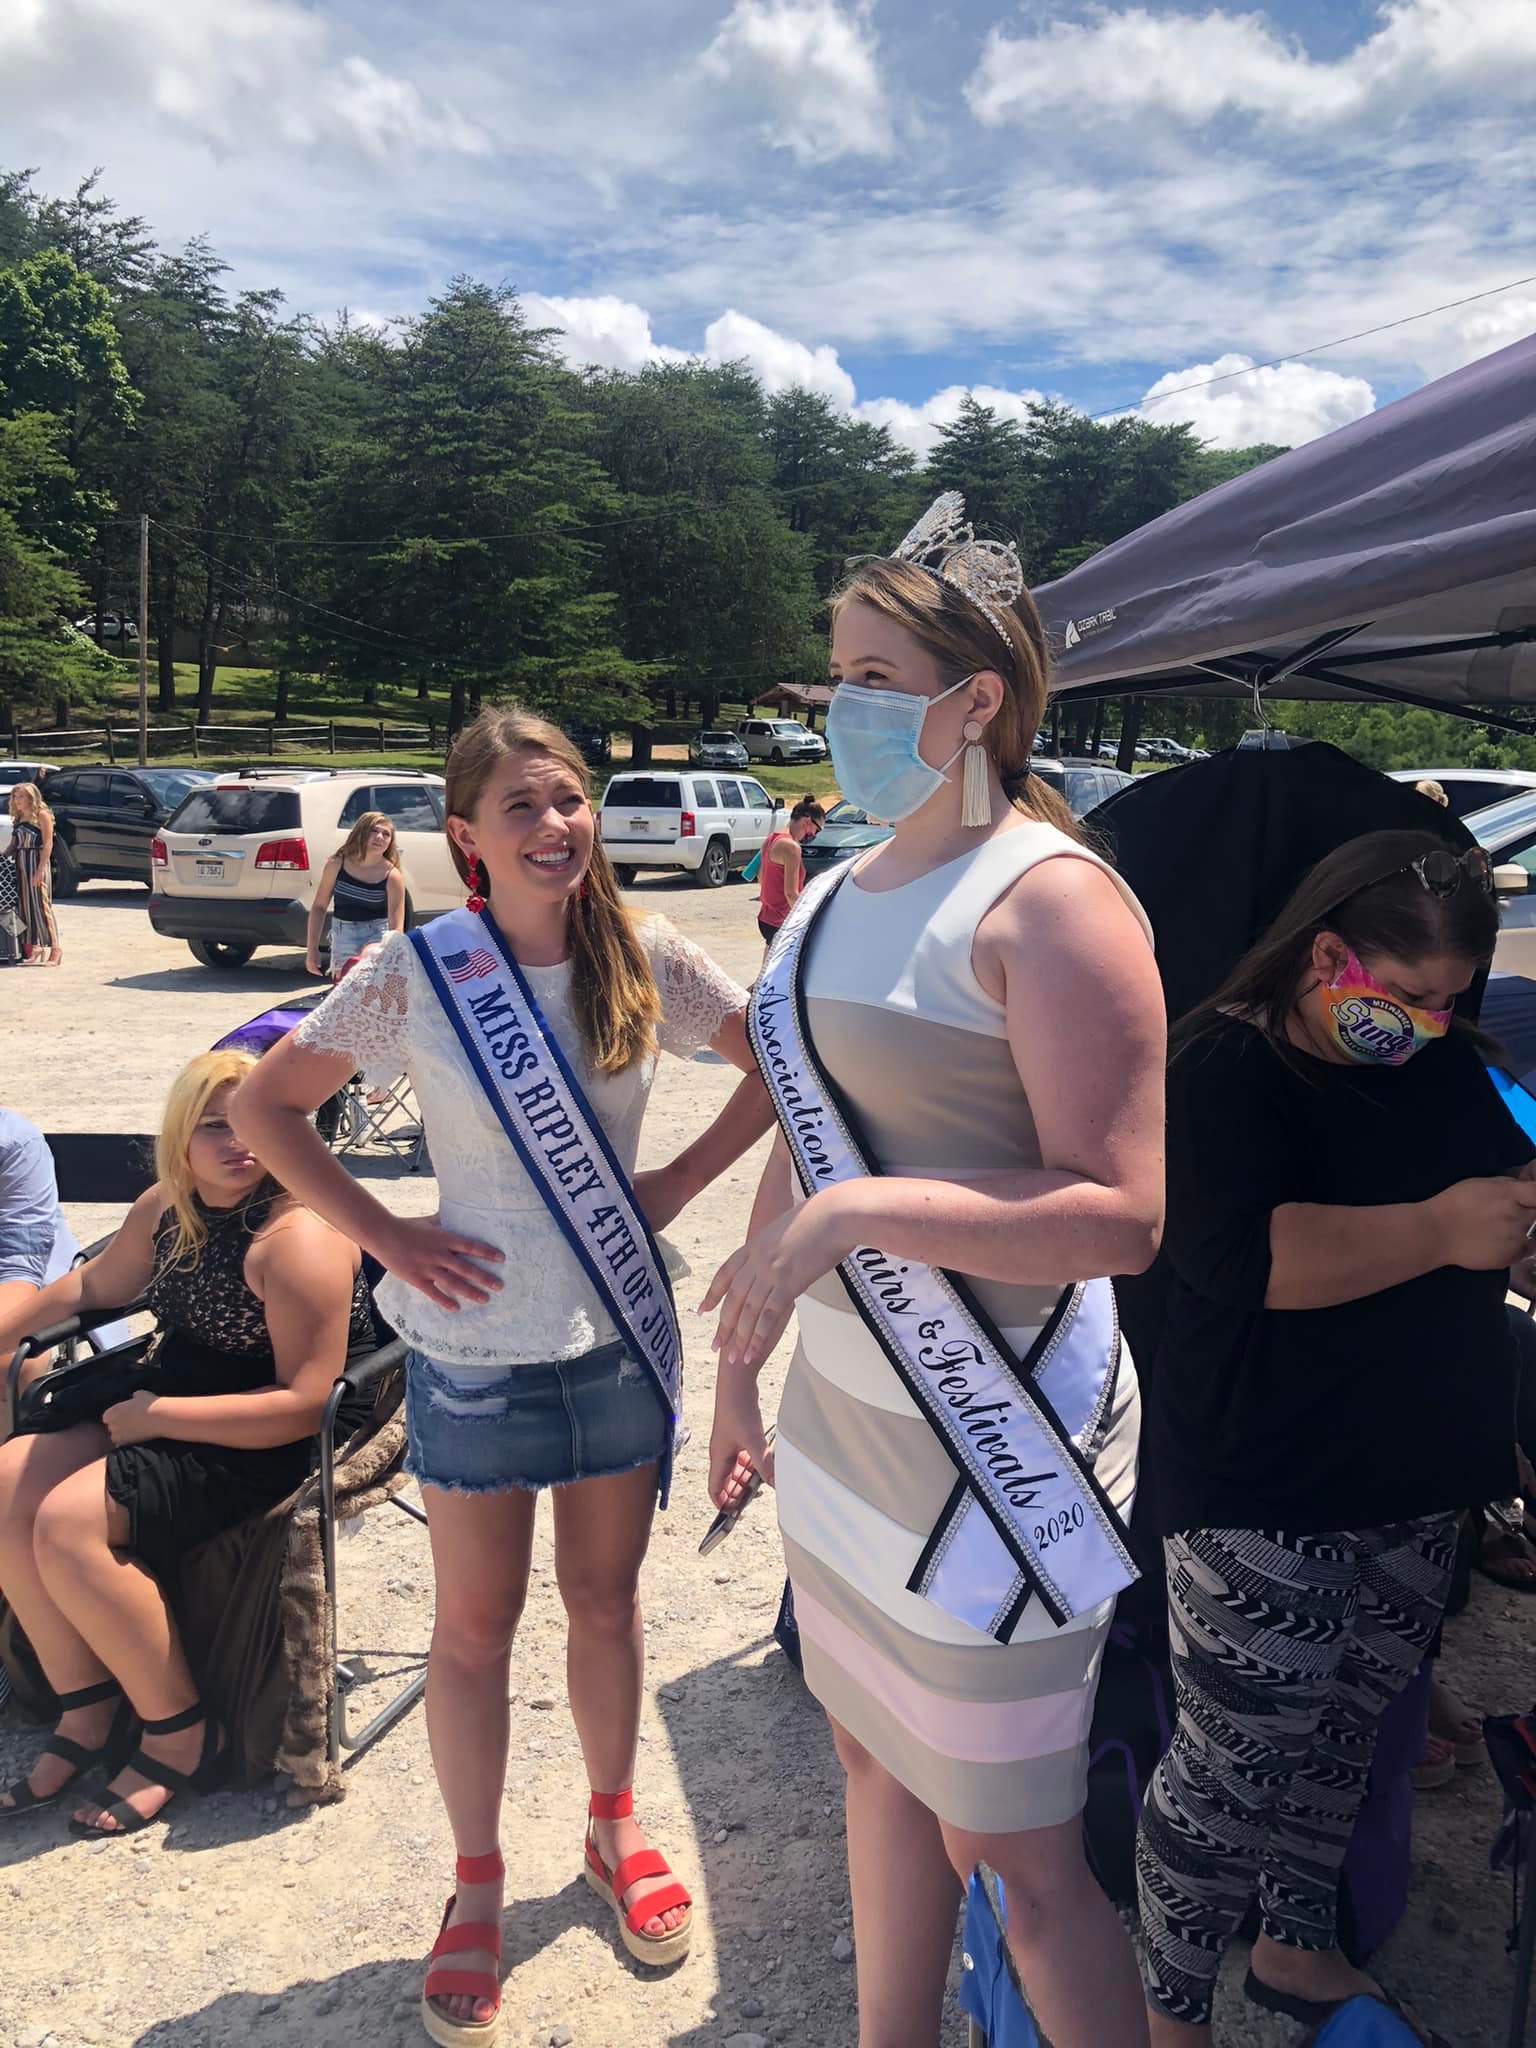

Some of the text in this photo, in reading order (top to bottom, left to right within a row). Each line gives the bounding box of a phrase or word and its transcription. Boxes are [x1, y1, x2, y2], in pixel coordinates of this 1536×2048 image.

[1329, 997, 1415, 1058] Sting
[758, 981, 837, 1182] Association
[467, 983, 540, 1081] MISS
[514, 1076, 606, 1203] RIPLEY
[586, 1205, 639, 1276] 4TH
[622, 1266, 654, 1311] OF
[856, 1248, 920, 1316] airs
[918, 1319, 946, 1341] &
[918, 1340, 1058, 1510] Festivals
[1033, 1502, 1086, 1552] 2020
